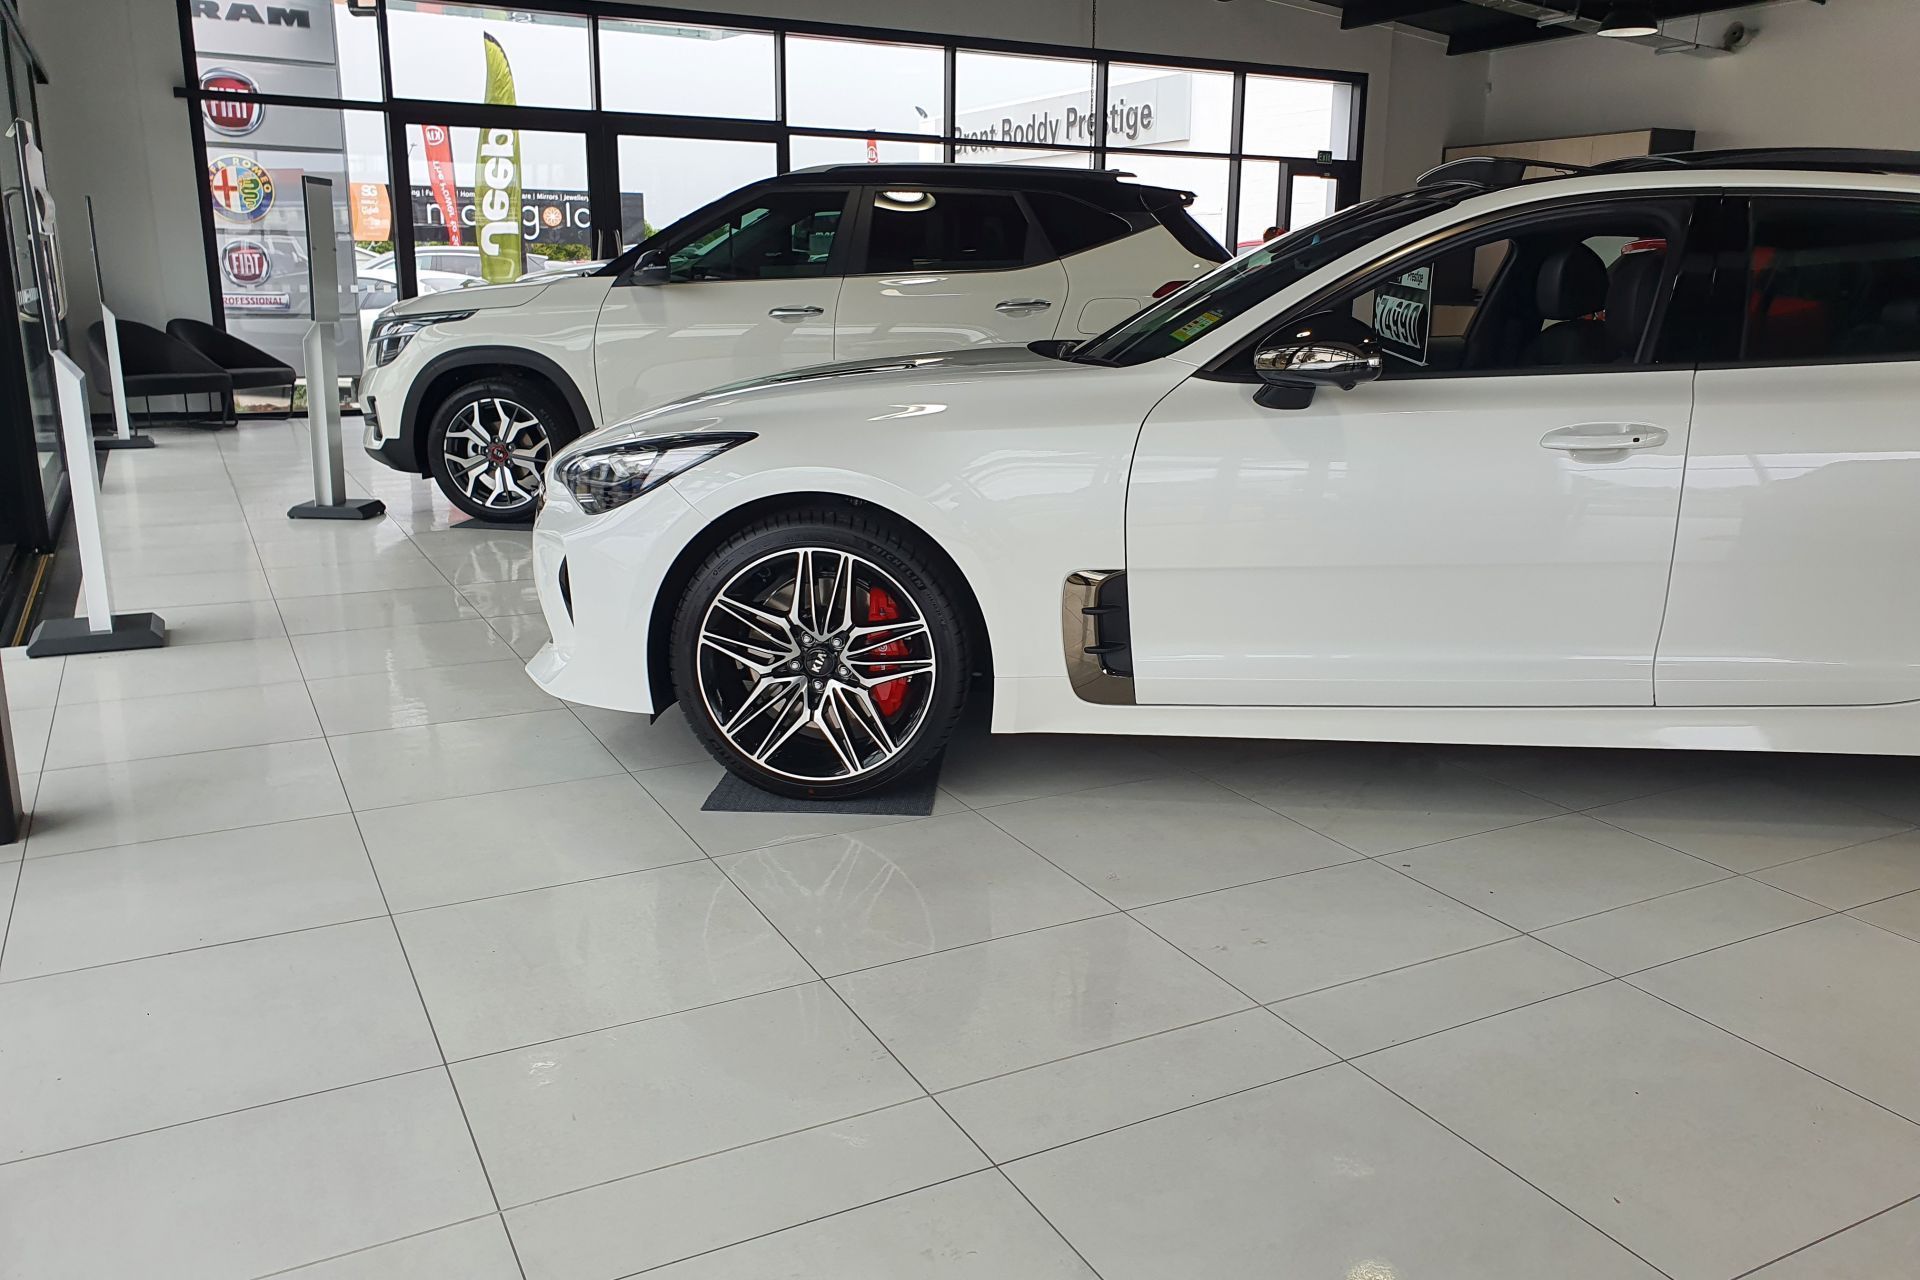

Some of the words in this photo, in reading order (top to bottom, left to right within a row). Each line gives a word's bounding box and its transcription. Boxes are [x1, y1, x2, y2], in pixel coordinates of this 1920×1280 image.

[191, 0, 310, 28] RAM
[1002, 111, 1060, 143] Boddy
[536, 193, 559, 201] Mirrors
[229, 251, 261, 275] FIAT
[223, 296, 284, 306] ROFESSIONAL
[811, 653, 827, 673] KIA
